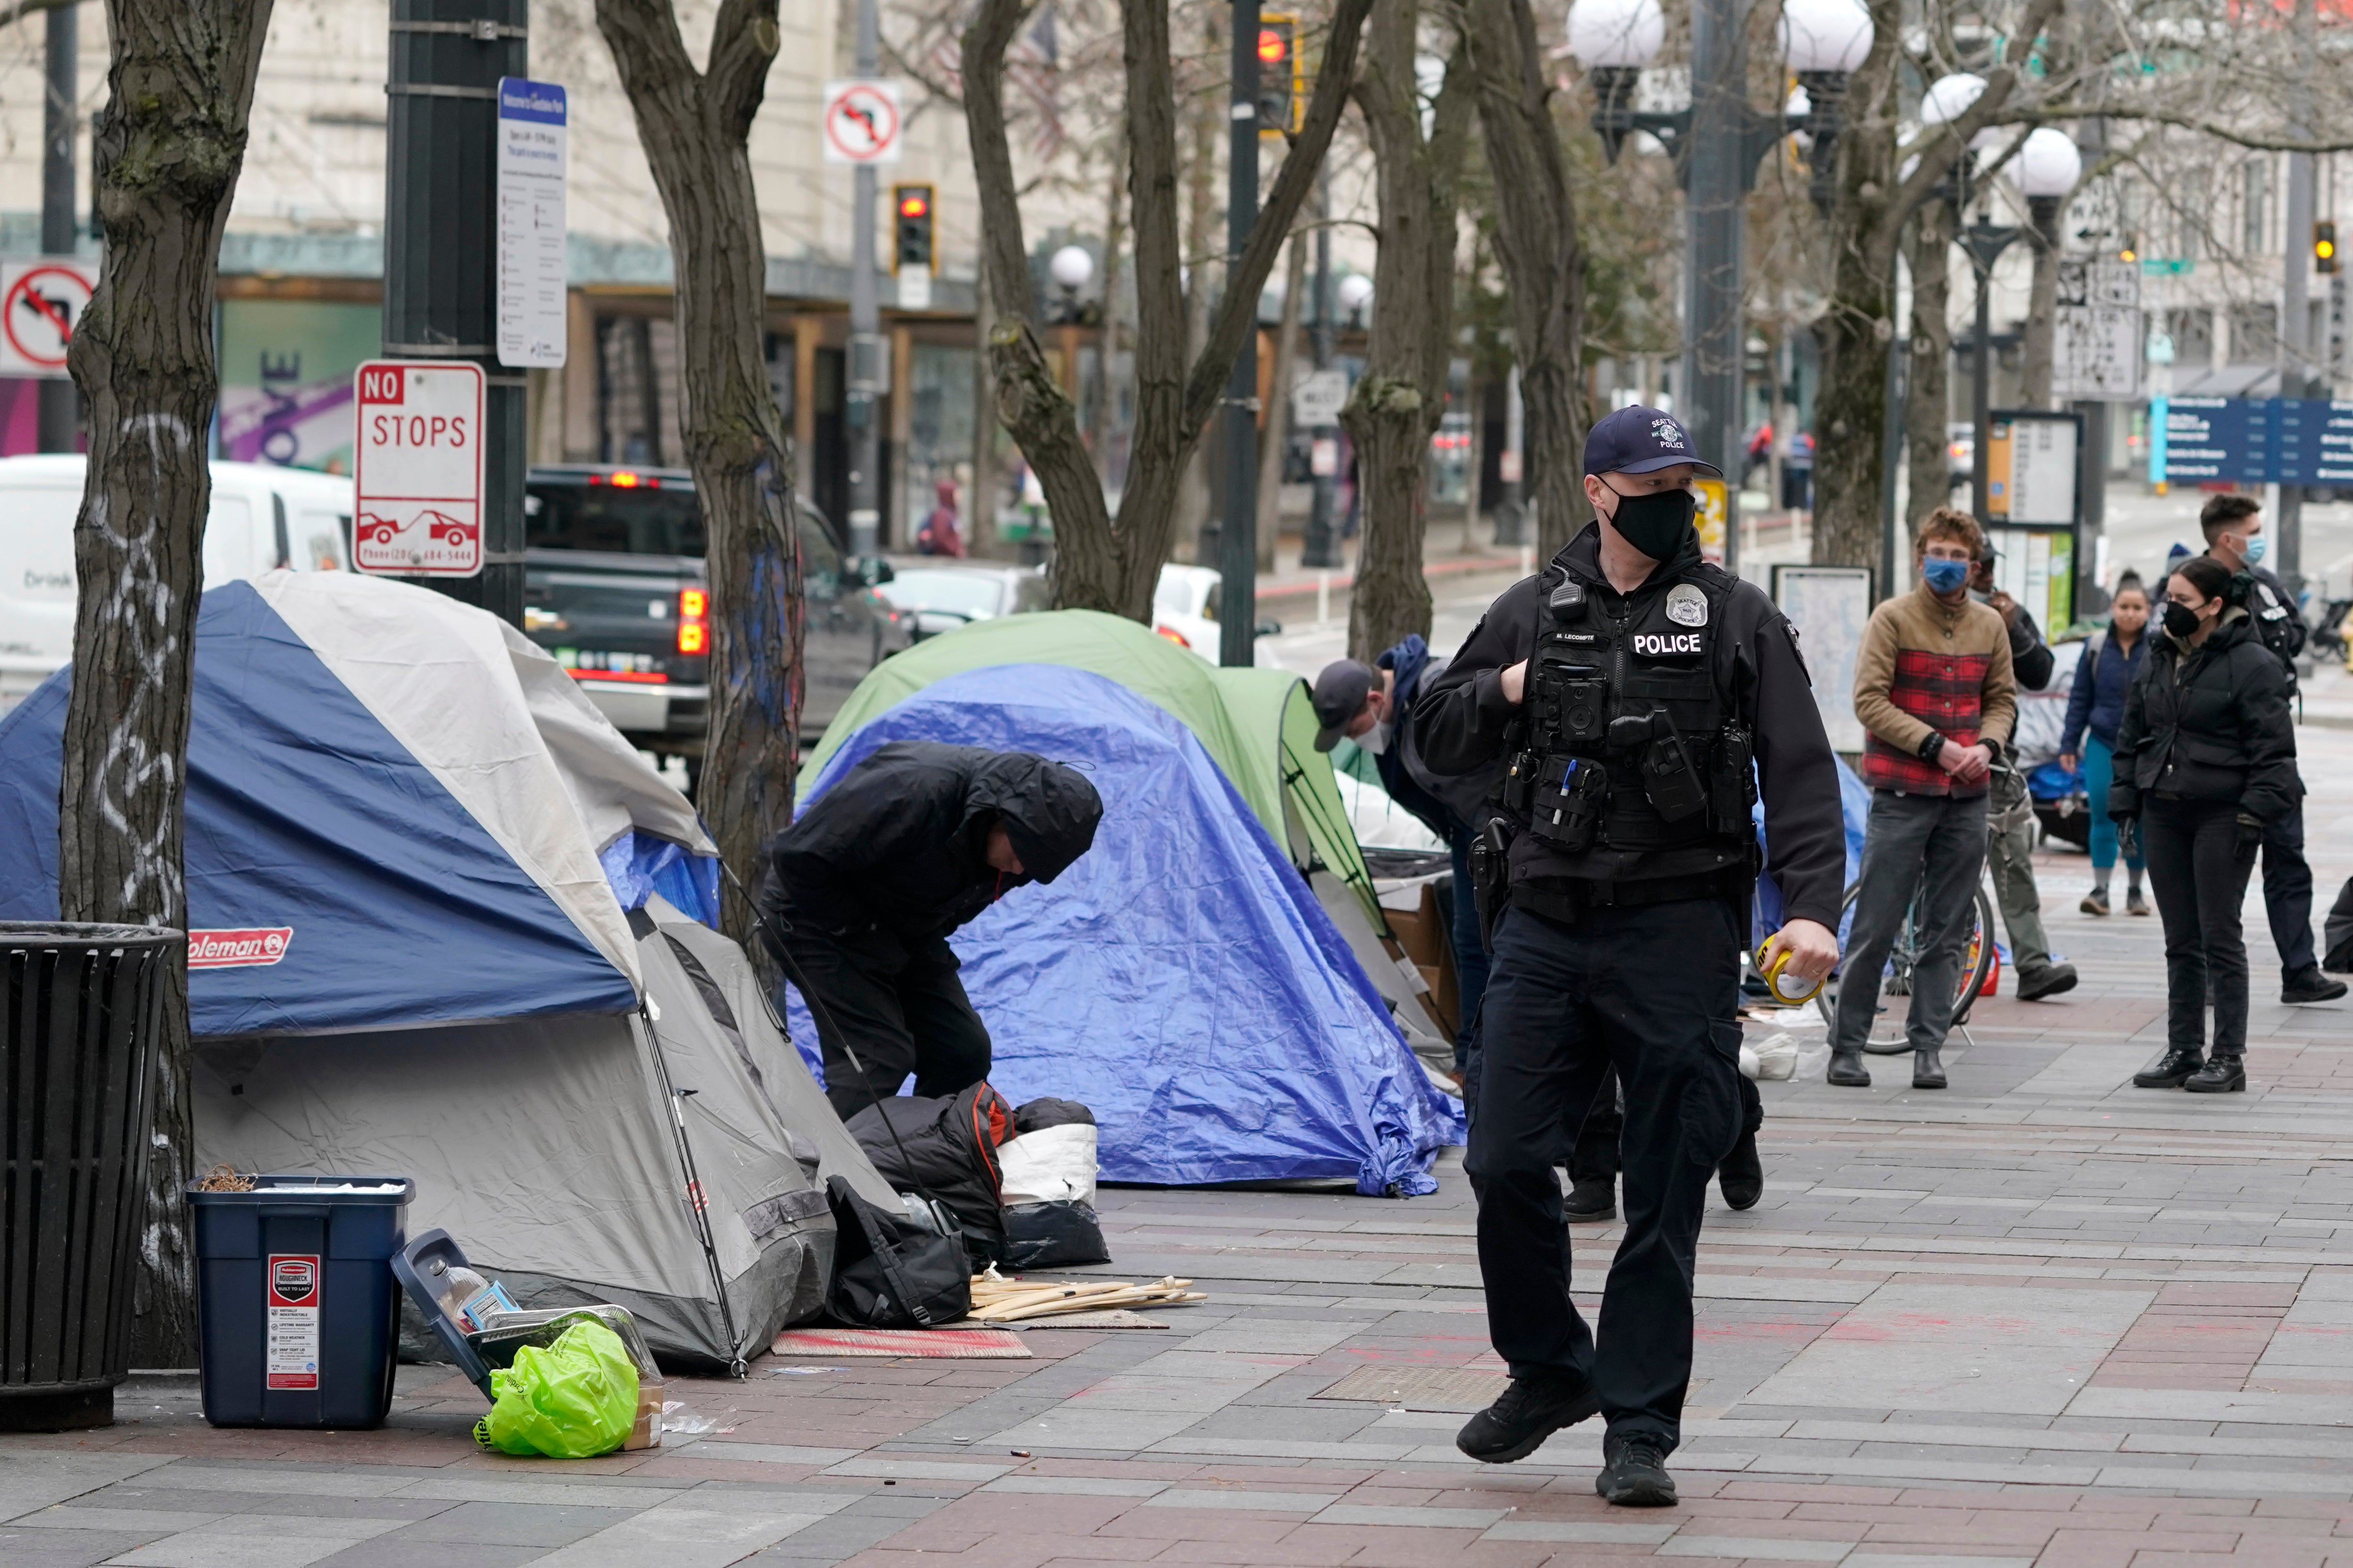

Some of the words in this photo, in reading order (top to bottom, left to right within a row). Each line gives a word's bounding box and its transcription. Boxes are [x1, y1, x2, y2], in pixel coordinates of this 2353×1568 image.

[365, 372, 397, 399] NO
[373, 415, 466, 447] STOPS
[1660, 441, 1685, 449] POLICE
[363, 549, 389, 560] Phone
[423, 550, 471, 561] 684-5444
[1634, 634, 1701, 654] POLICE
[188, 935, 262, 957] oleman
